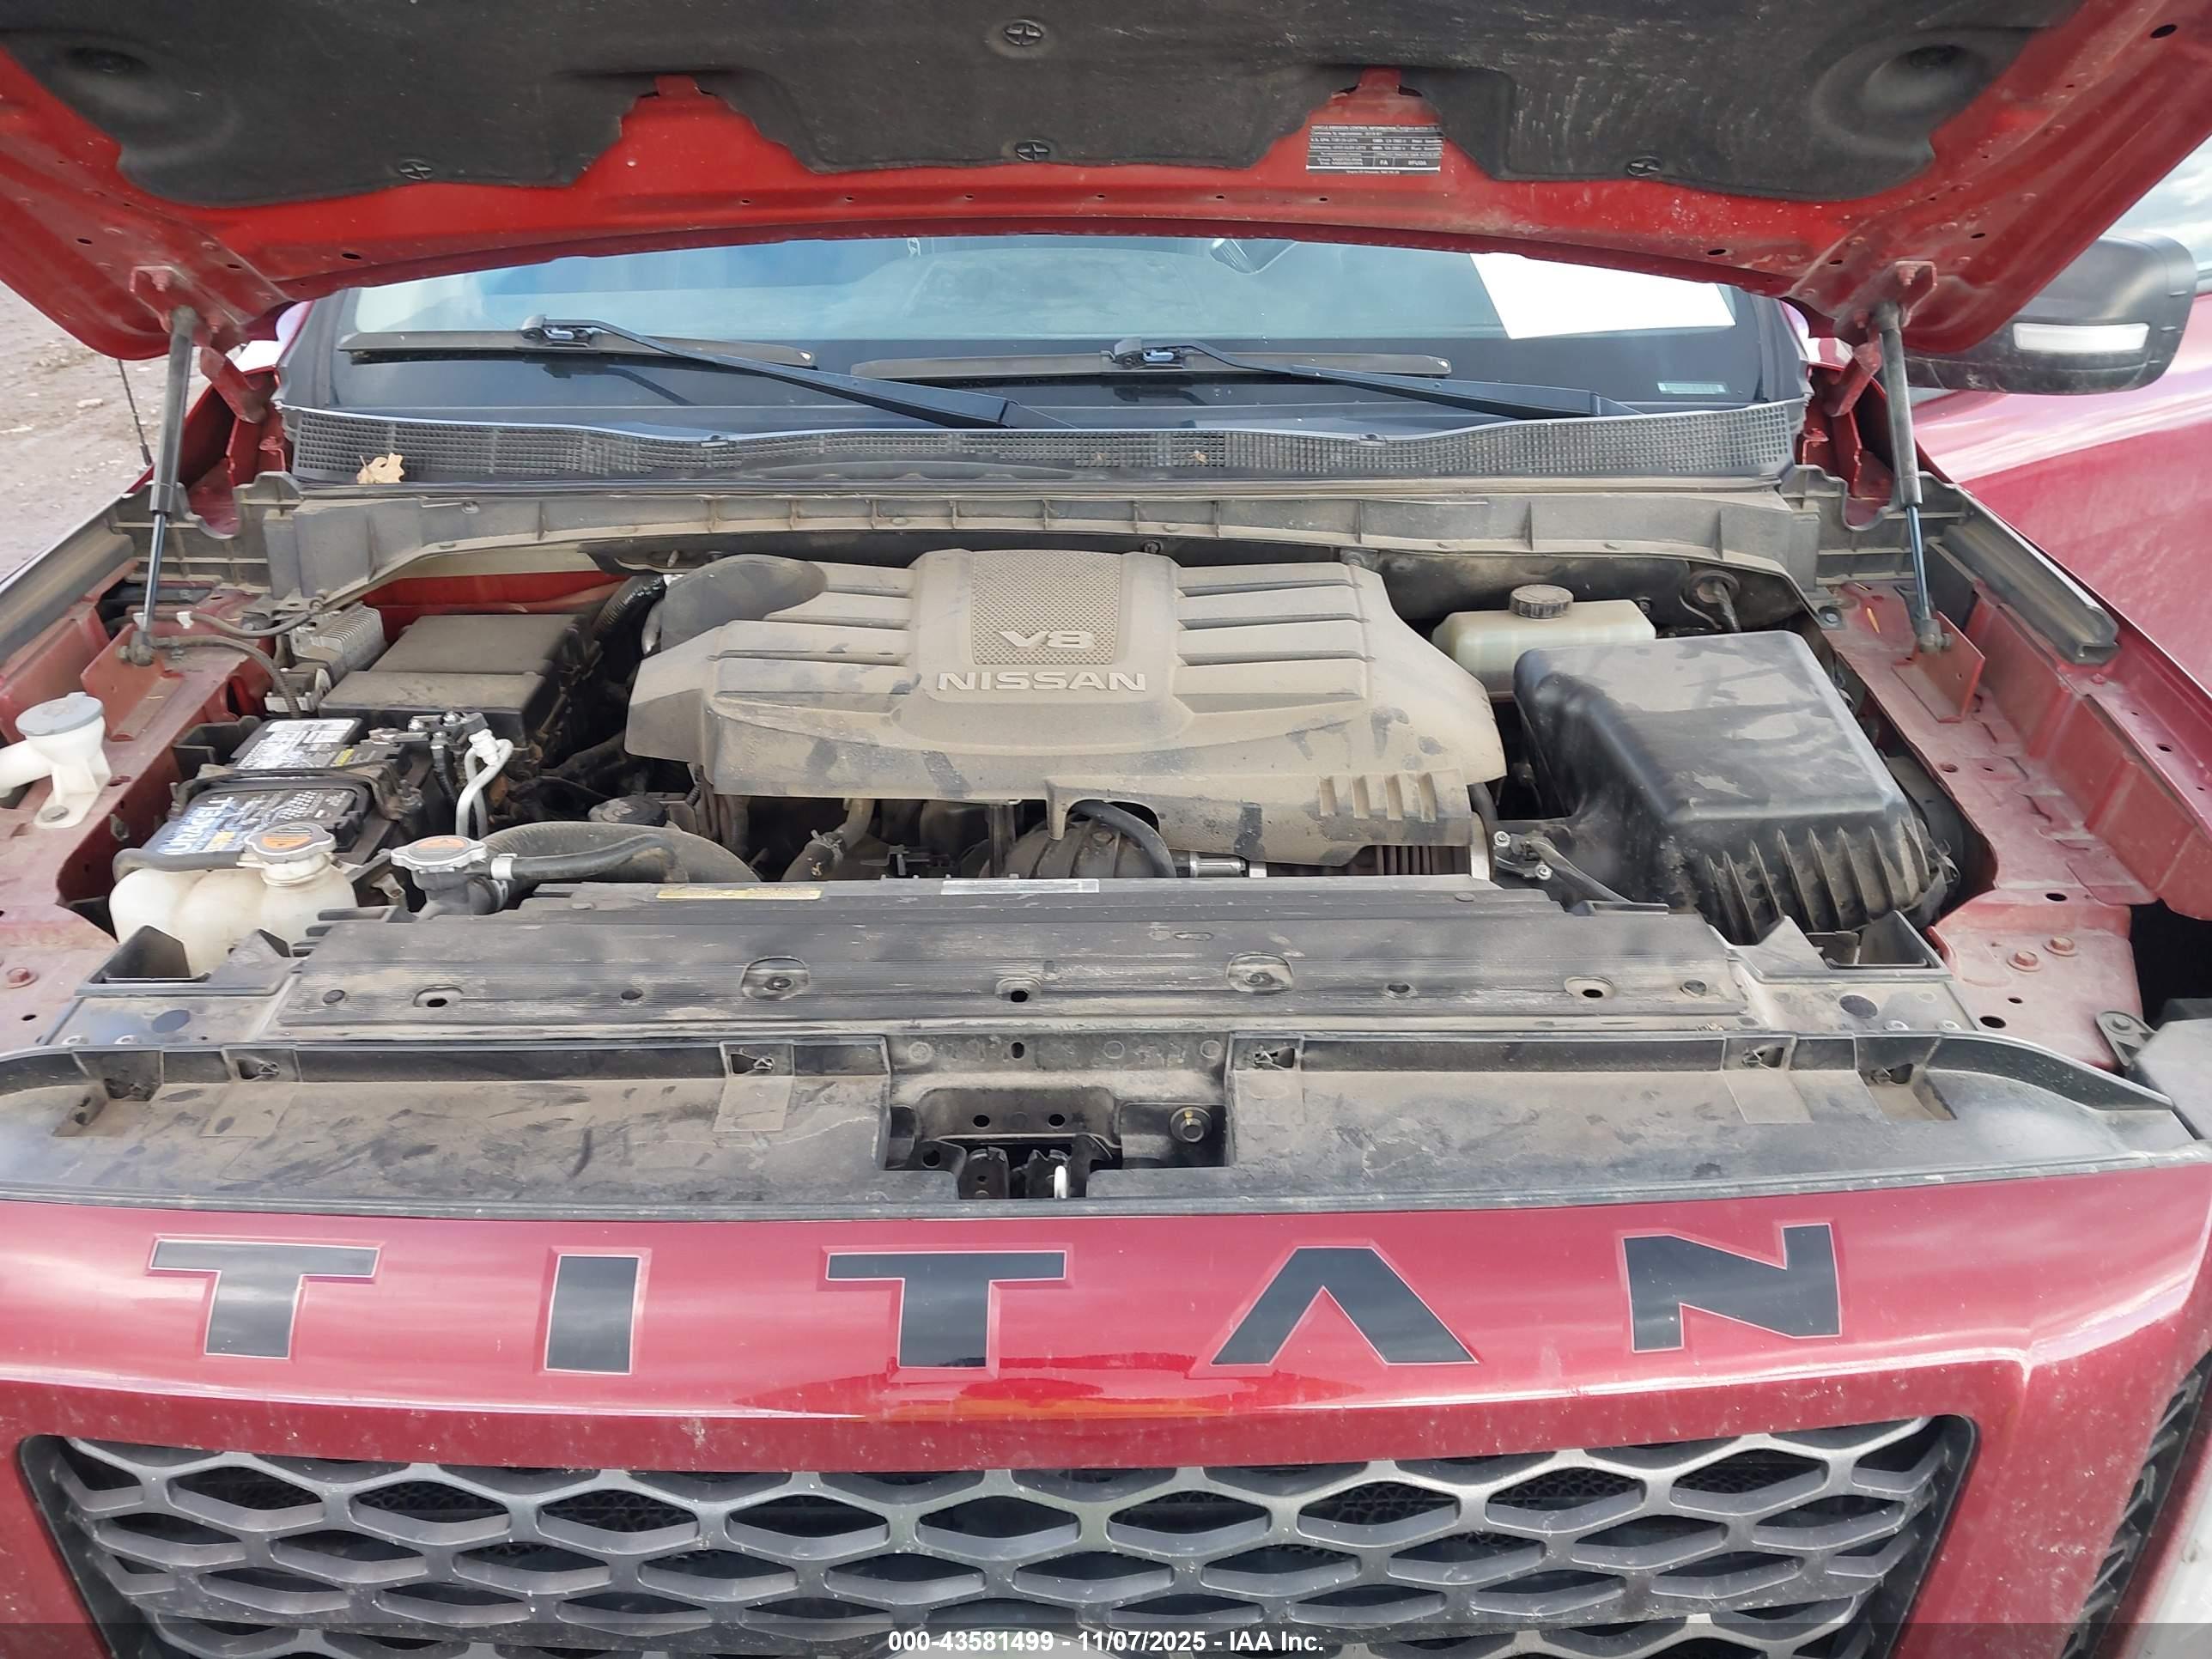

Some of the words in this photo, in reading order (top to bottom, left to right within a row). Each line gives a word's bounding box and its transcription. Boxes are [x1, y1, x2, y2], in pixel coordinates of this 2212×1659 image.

[996, 630, 1095, 649] V8
[936, 671, 1147, 692] NISSAN
[148, 1220, 1843, 1375] TITAN
